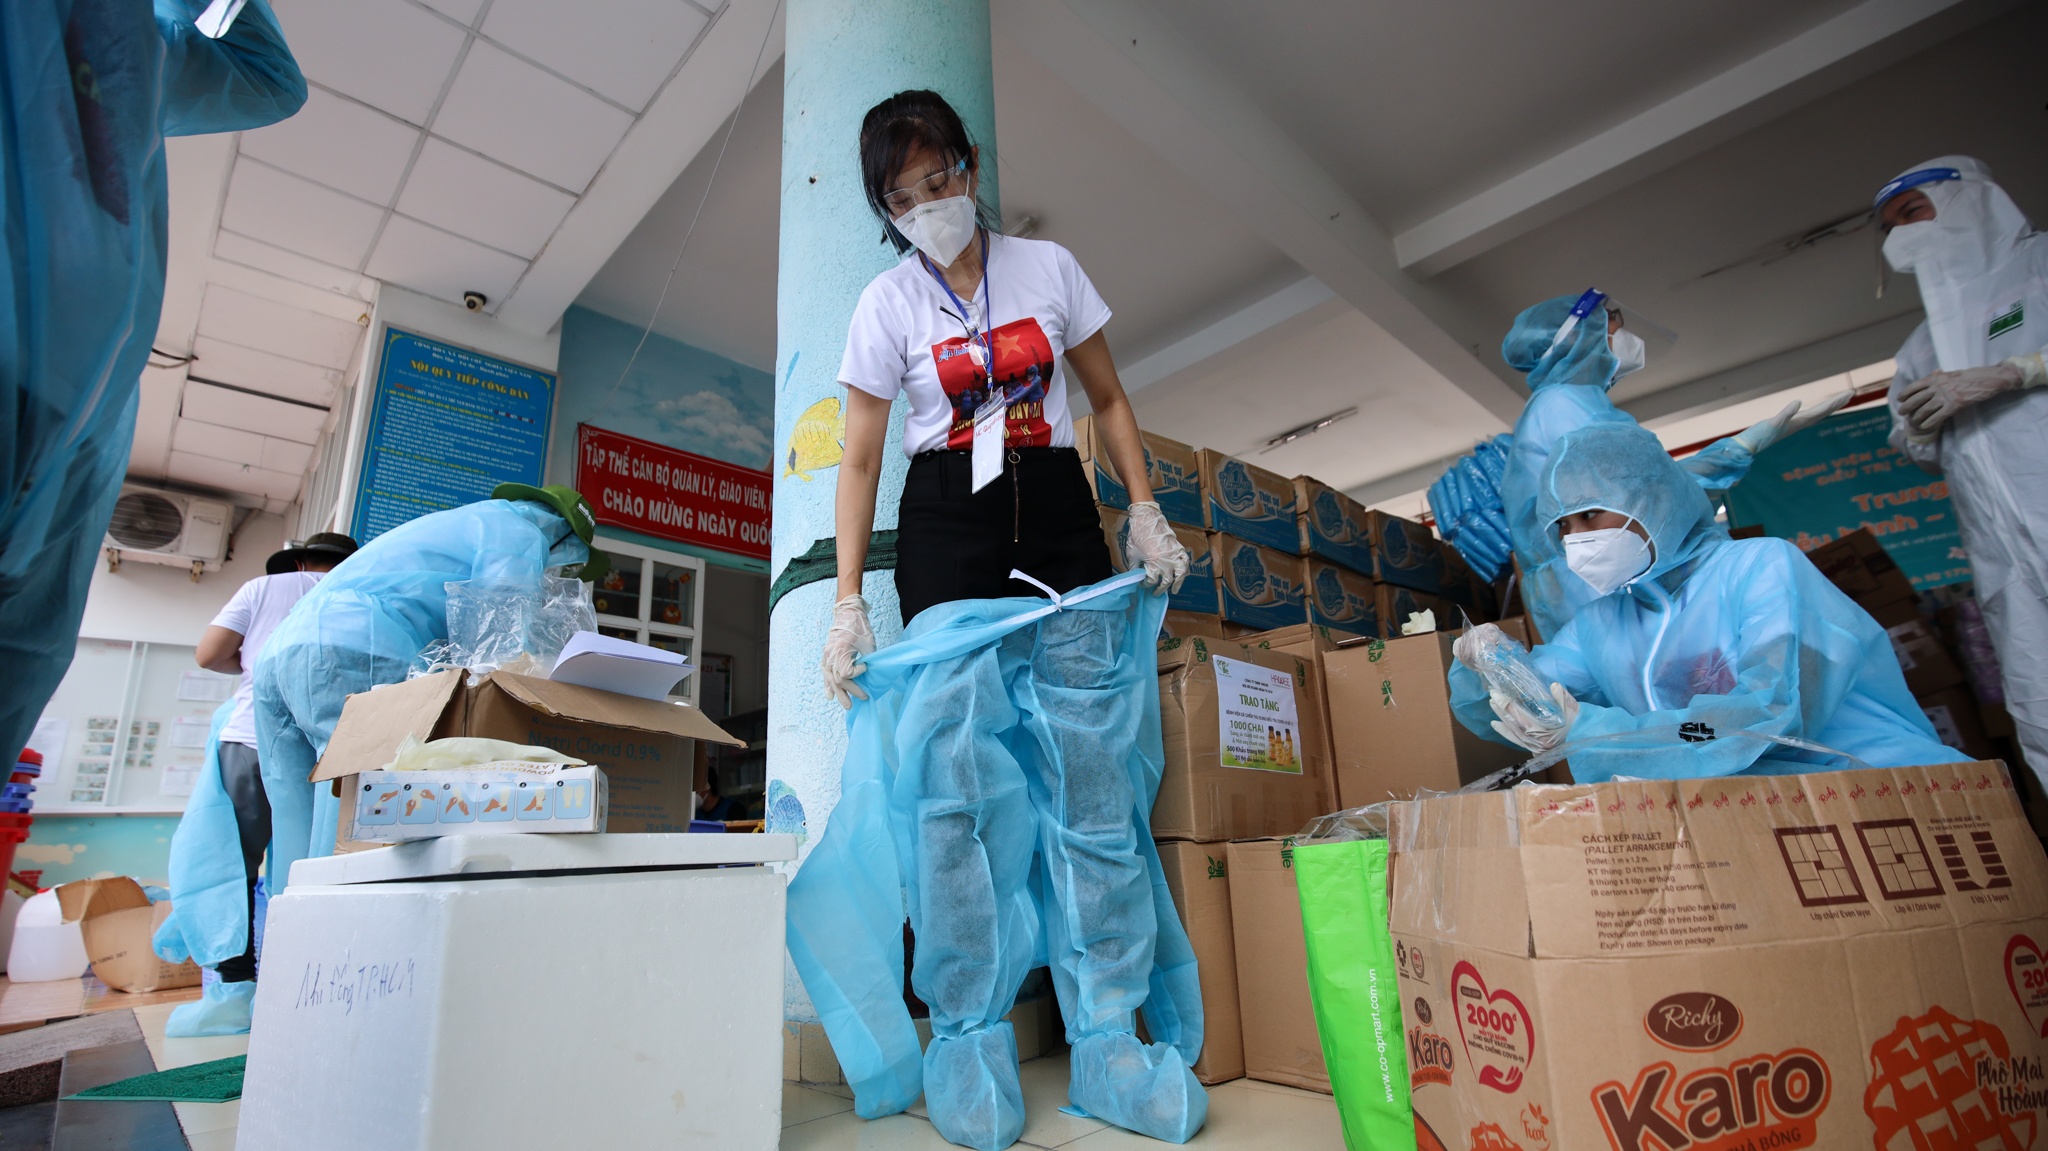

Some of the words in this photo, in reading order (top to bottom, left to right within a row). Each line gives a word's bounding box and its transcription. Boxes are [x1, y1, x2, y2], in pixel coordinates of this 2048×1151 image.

[411, 360, 429, 372] NỘI
[432, 366, 452, 378] QUY
[456, 370, 479, 386] TIẾP
[482, 378, 506, 394] CÔNG
[510, 387, 530, 400] DÂN
[1157, 460, 1172, 474] Thật
[1784, 462, 1826, 480] BỆNH
[1831, 452, 1872, 468] VIỆN
[1862, 462, 1892, 475] TRỊ
[586, 443, 605, 472] TẬP
[608, 445, 630, 476] THỂ
[632, 454, 652, 480] CÁN
[656, 461, 670, 492] BỘ
[672, 464, 699, 494] QUẢN
[702, 472, 716, 502] LÝ,
[719, 478, 742, 504] GIÁO
[744, 484, 766, 514] VIÊN,
[1163, 474, 1178, 487] Tinh
[1180, 478, 1195, 492] khiết
[1259, 491, 1271, 502] Thật
[1852, 480, 1949, 512] Trung
[602, 487, 644, 518] CHÀO
[648, 497, 694, 529] MỪNG
[697, 511, 737, 538] NGÀY
[1368, 642, 1376, 662] one
[1239, 694, 1259, 707] TRAO
[1260, 698, 1280, 712] TẶNG
[1230, 720, 1246, 730] 1000
[1248, 723, 1264, 733] CHAI
[528, 731, 570, 752] Natri
[576, 736, 622, 758] Clorid
[625, 743, 662, 762] 0,9%
[501, 767, 555, 776] POWDER
[1582, 832, 1611, 844] CÁCH
[1614, 832, 1630, 842] XẾP
[1632, 832, 1662, 841] PALLET
[1584, 845, 1624, 856] (PALLET
[1626, 841, 1691, 852] ARRANGEMENT)
[1281, 850, 1293, 868] life
[1586, 857, 1610, 865] Pallet:
[1631, 856, 1640, 864] 1,2
[1214, 861, 1225, 878] life
[1601, 867, 1624, 877] thùng:
[1632, 866, 1644, 874] 470
[1596, 878, 1618, 886] thùng
[1631, 876, 1641, 885] lớp
[1641, 887, 1659, 896] layers
[1676, 883, 1705, 891] cartons)
[1992, 894, 2009, 902] layers
[1595, 910, 1615, 918] Ngày
[1617, 908, 1630, 916] sản
[1659, 906, 1675, 915] ngày
[1678, 905, 1696, 913] trước
[1720, 902, 1736, 912] dụng
[1810, 912, 1823, 922] Lớp
[1841, 910, 1856, 918] Even
[1857, 908, 1871, 918] layer
[1894, 905, 1905, 914] Lớp
[1916, 903, 1927, 911] Odd
[1928, 902, 1942, 911] layer
[1597, 921, 1612, 929] Hạn
[1614, 919, 1623, 928] sử
[1643, 917, 1666, 927] (HSD):
[1677, 916, 1691, 924] trên
[1599, 930, 1638, 940] Production
[1670, 927, 1687, 936] days
[1689, 925, 1712, 934] before
[1714, 925, 1733, 934] expiry
[1734, 923, 1748, 931] date
[1600, 941, 1624, 951] Expiry
[1627, 940, 1645, 948] date:
[1647, 939, 1672, 947] Shown
[1685, 936, 1715, 946] package
[296, 962, 322, 1009] Nhi
[1659, 997, 1724, 1042] Richy
[1369, 968, 1393, 1103] www.co-opmart.com.vn
[1410, 1030, 1452, 1070] Karo
[1468, 1040, 1484, 1051] PHÒNG,
[1485, 1045, 1501, 1056] CHỐNG
[1503, 1050, 1524, 1063] COVID-19
[1494, 1040, 1515, 1051] VACCINE
[1976, 1056, 2008, 1088] Phô
[2012, 1057, 2044, 1084] Mai
[1597, 1053, 1828, 1151] Karo
[1759, 1126, 1802, 1150] BÔNG
